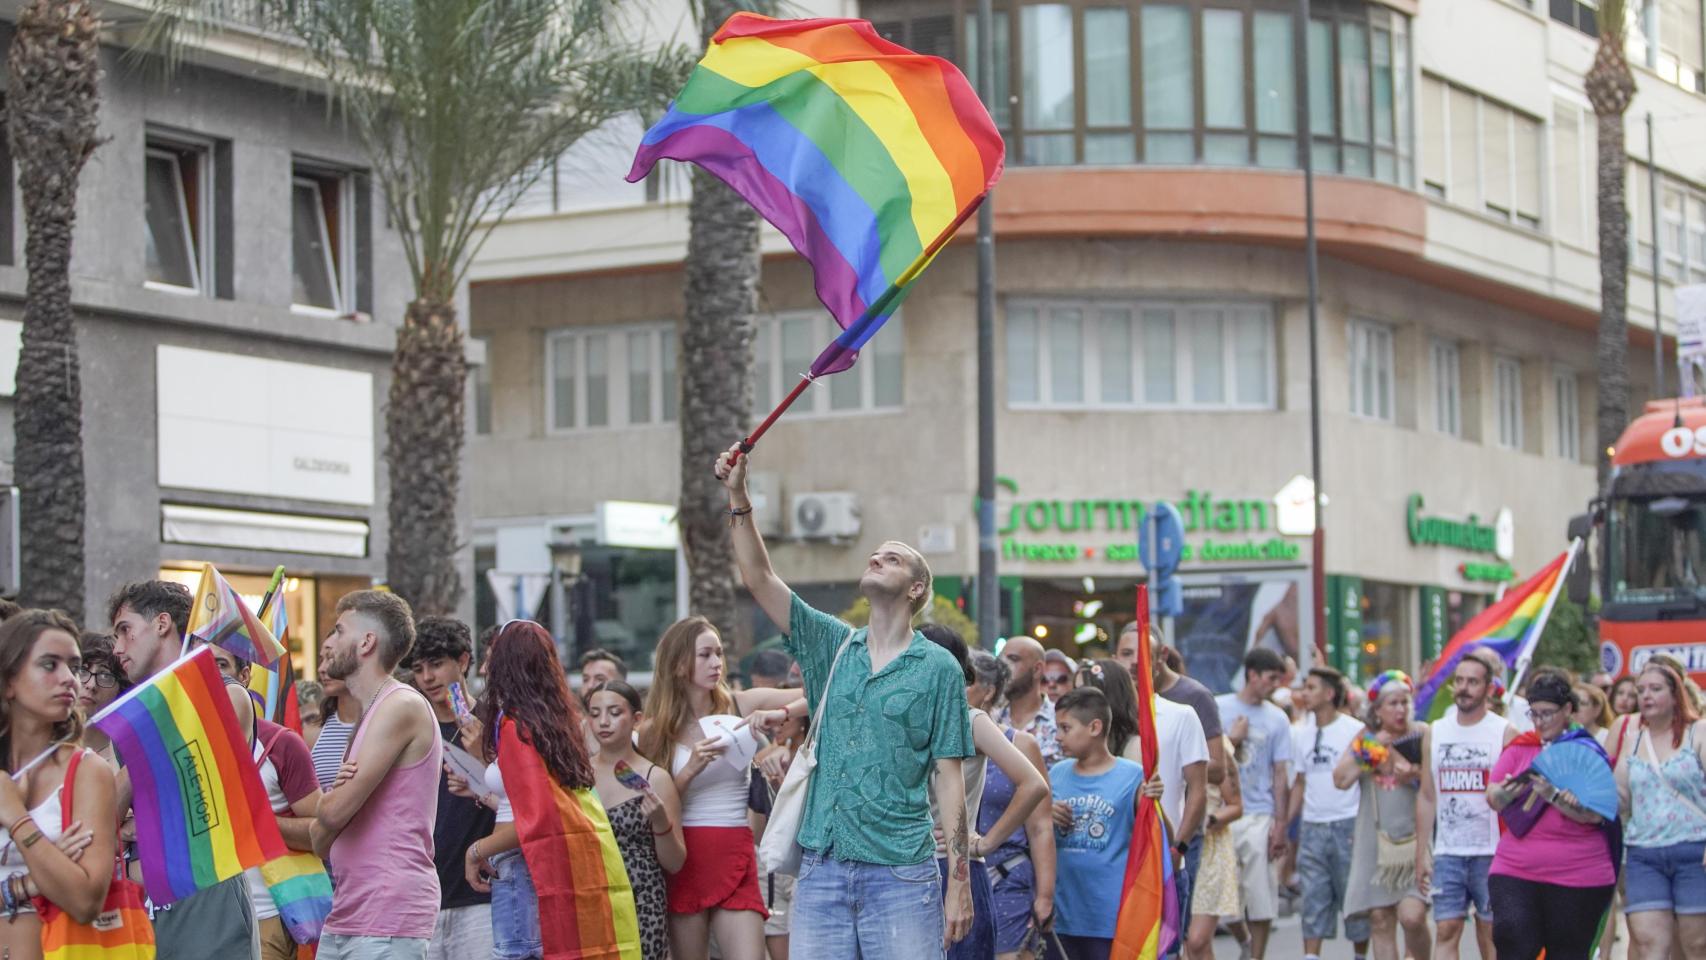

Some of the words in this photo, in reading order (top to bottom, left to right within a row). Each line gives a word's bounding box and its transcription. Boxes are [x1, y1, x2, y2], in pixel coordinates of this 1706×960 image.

[974, 476, 1267, 535] Gourmdian
[1003, 537, 1078, 561] fresco
[183, 755, 211, 824] ALE-HOP
[1440, 769, 1485, 791] MARVEL
